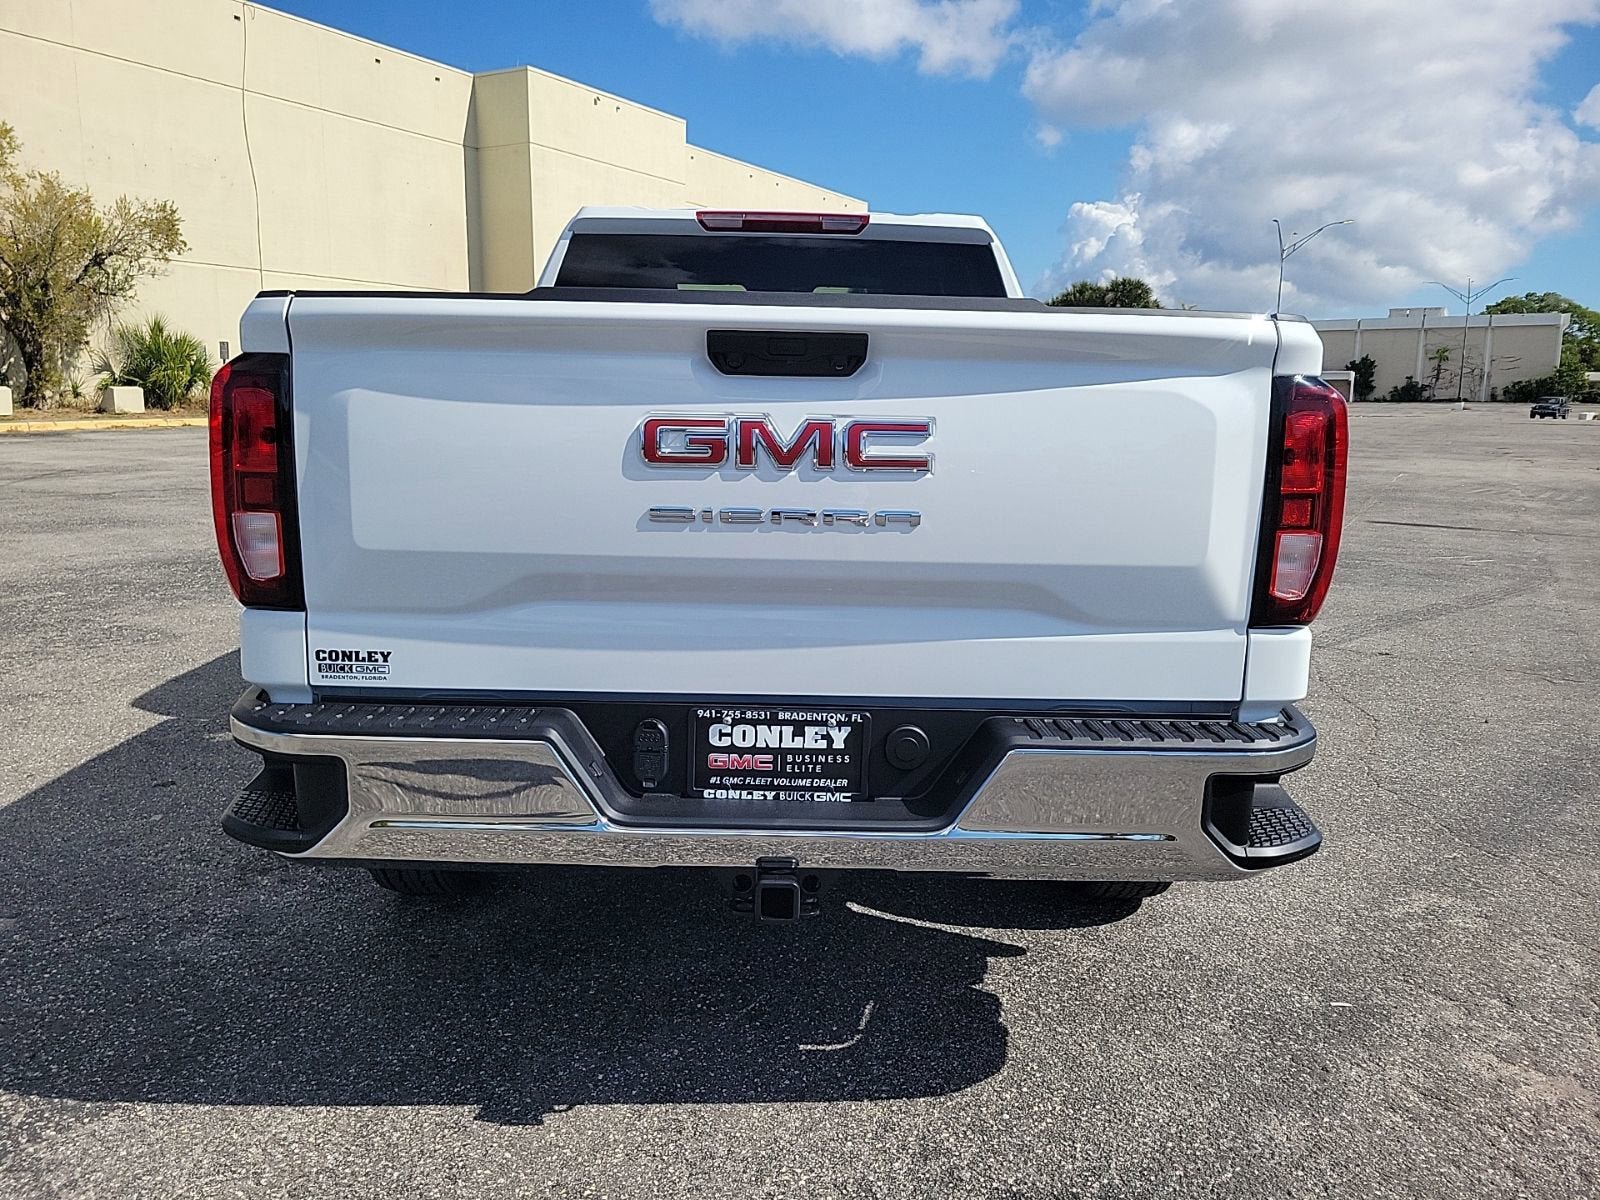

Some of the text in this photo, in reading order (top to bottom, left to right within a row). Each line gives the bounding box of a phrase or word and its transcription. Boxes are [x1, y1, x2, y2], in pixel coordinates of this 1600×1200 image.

[640, 411, 936, 474] GMC
[649, 505, 921, 527] SIERRA
[315, 649, 392, 663] CONLEY
[321, 664, 388, 673] BUICK GMC
[697, 709, 863, 722] 941-755-8531 BRADENTON, FL
[708, 723, 851, 749] CONLEY
[708, 753, 774, 770] GMC
[786, 754, 850, 763] BUSINESS
[786, 765, 822, 773] ELITE
[722, 777, 744, 785] GMC
[773, 778, 812, 787] VOLUME
[813, 779, 848, 787] DEALER
[703, 789, 852, 802] CONLEY BUICK GMC
